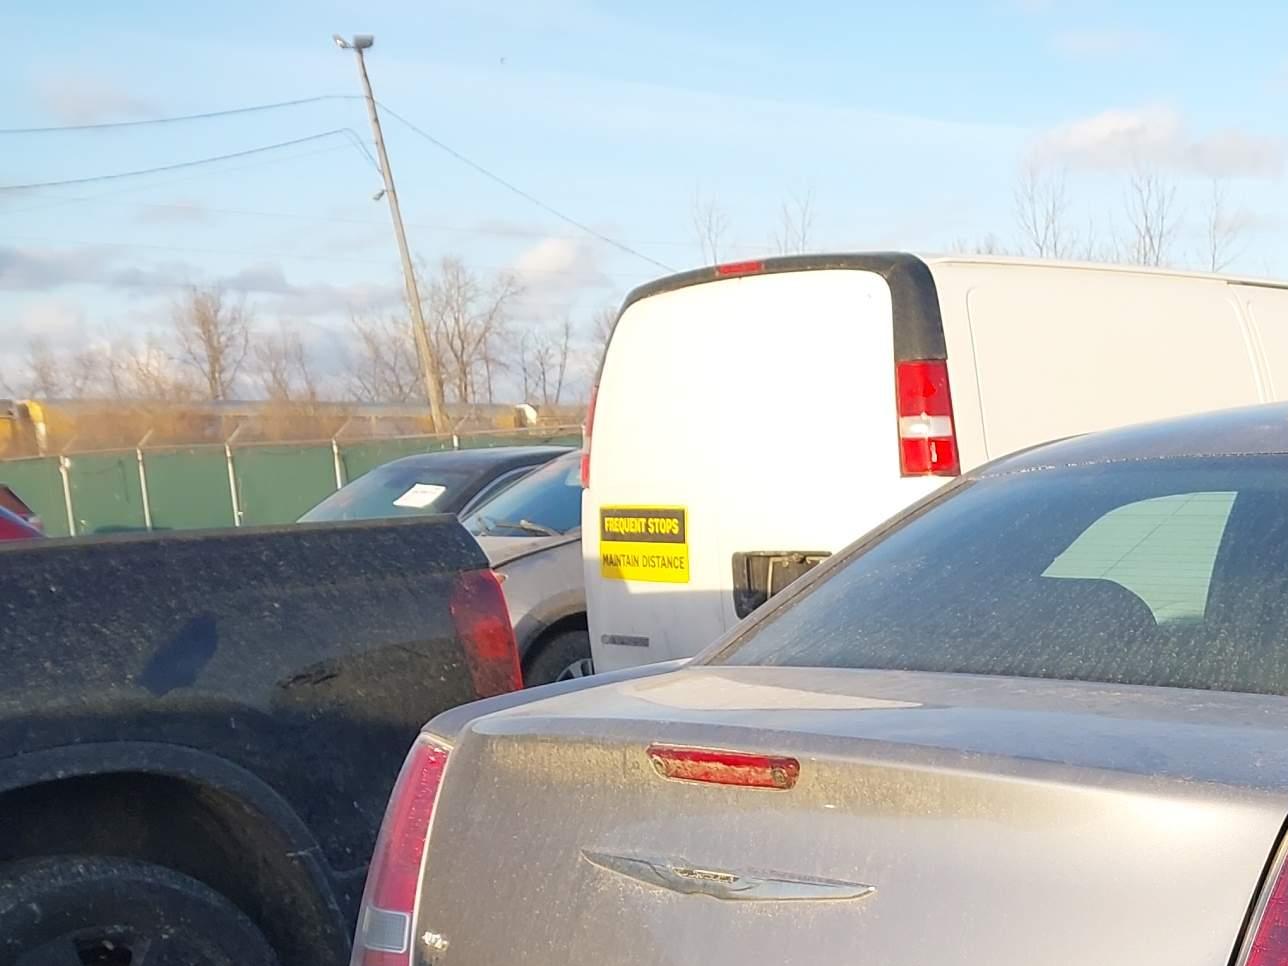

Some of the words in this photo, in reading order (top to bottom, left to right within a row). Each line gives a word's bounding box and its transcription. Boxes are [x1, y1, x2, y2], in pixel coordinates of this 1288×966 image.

[604, 517, 646, 534] FREQUENT
[647, 518, 679, 535] STOPS
[602, 554, 640, 568] MAINTAIN
[642, 555, 685, 570] DISTANCE
